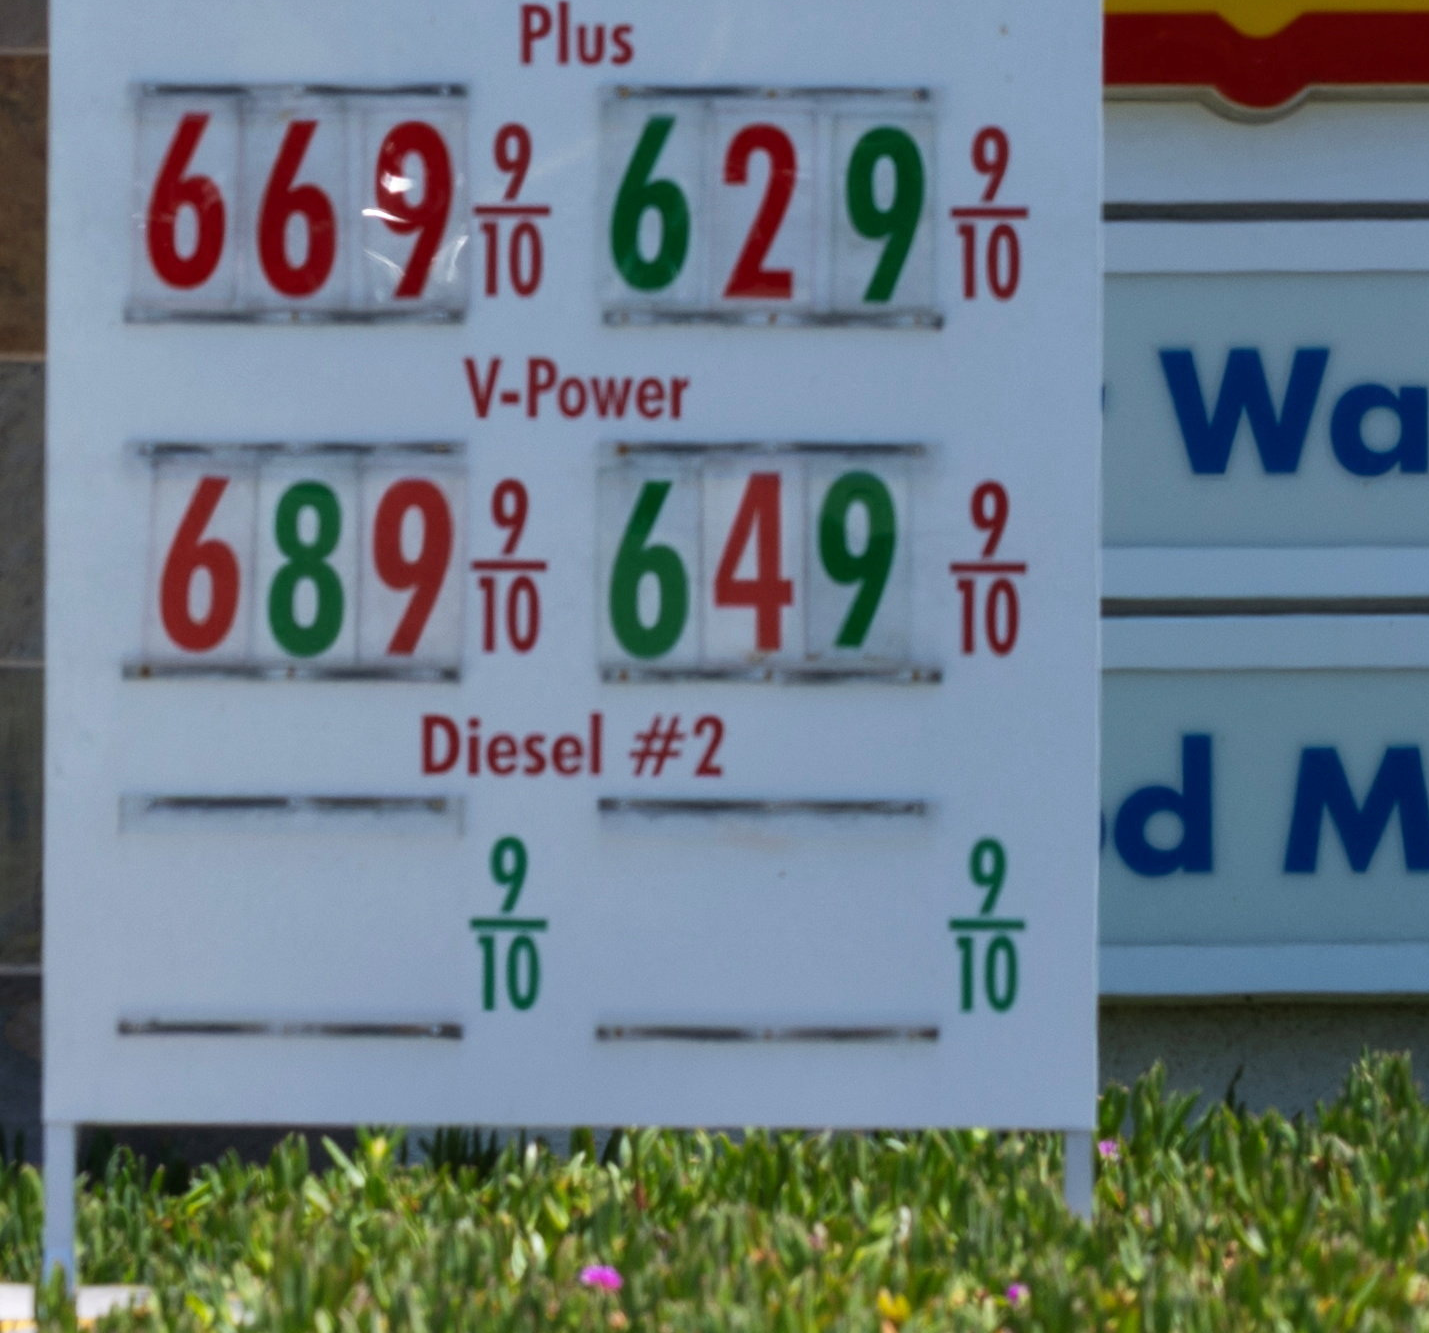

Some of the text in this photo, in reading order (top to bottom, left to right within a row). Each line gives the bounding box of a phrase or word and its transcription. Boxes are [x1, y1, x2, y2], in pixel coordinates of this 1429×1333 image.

[519, 0, 635, 67] Plus
[142, 110, 456, 301] 669
[610, 116, 926, 303] 629
[462, 356, 690, 421] V-Power
[157, 474, 456, 658] 689
[608, 471, 898, 660] 649
[420, 711, 726, 778] Diesel #2
